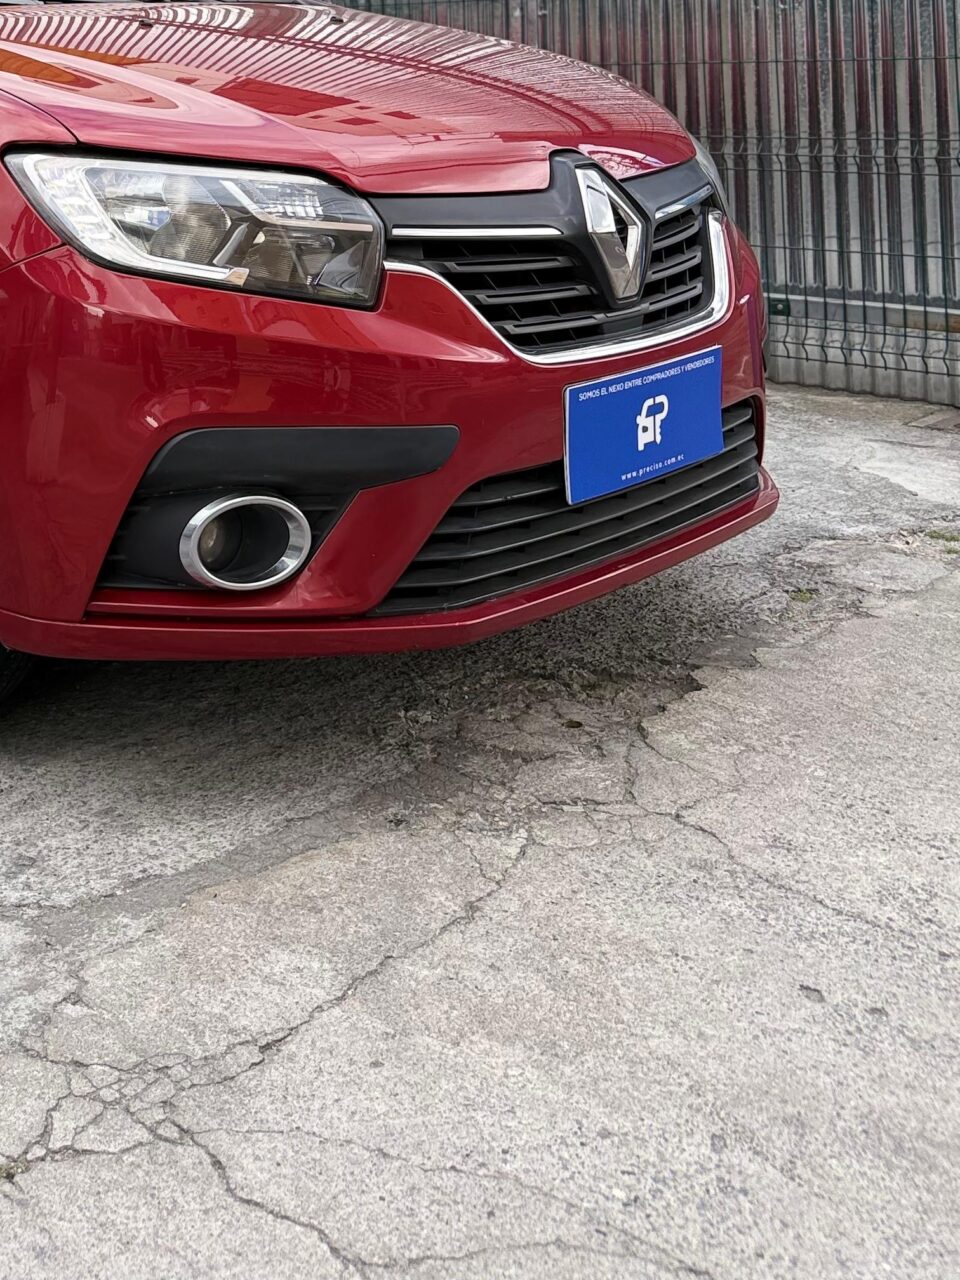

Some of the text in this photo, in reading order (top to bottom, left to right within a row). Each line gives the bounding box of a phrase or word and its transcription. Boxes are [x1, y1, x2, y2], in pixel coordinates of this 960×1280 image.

[578, 388, 600, 401] SOMOS
[601, 387, 608, 396] EL
[608, 382, 624, 393] NEXO
[624, 377, 642, 390] ENTRE
[642, 366, 680, 384] COMPRADORES
[685, 356, 715, 371] VENDEDORES
[621, 454, 684, 480] www.preciso.com.ec
